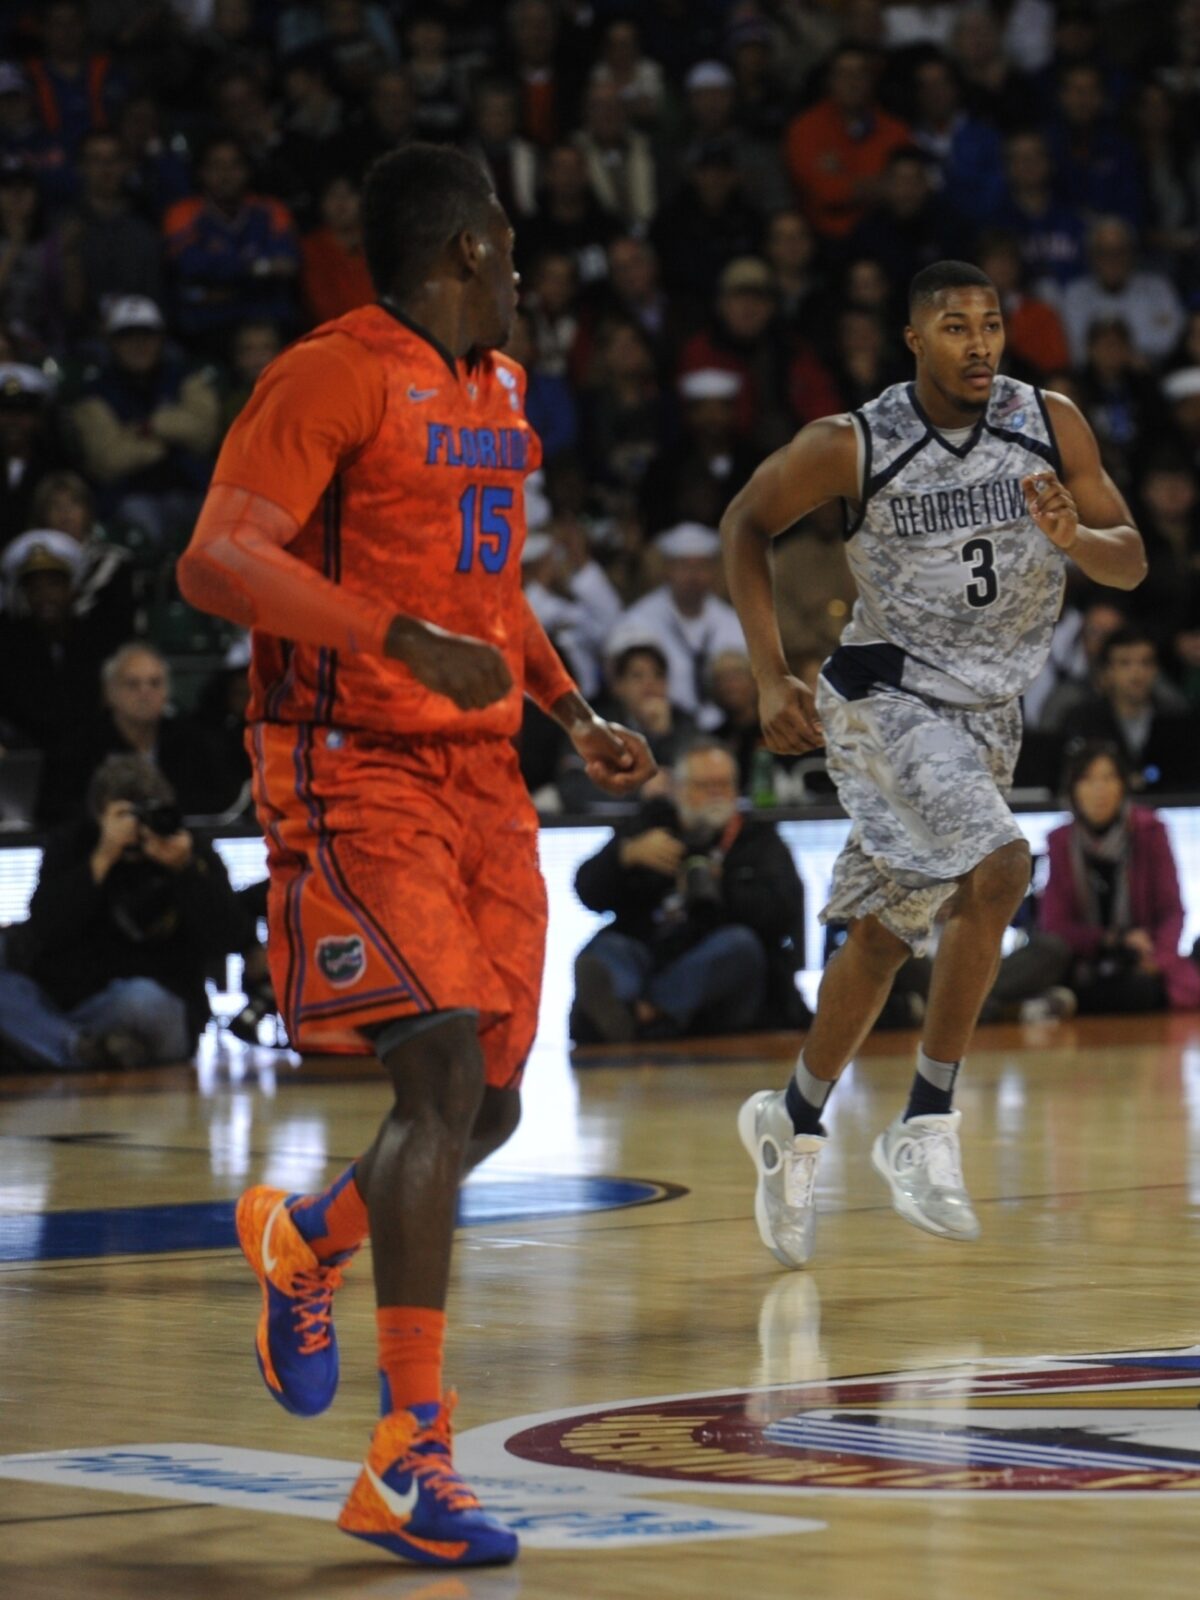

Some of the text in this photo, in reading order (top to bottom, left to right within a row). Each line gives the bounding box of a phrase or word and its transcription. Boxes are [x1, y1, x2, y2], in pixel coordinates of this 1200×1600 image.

[427, 422, 530, 470] FLORID
[457, 484, 513, 573] 15
[889, 477, 1028, 537] GEORGETOW
[962, 538, 998, 607] 3
